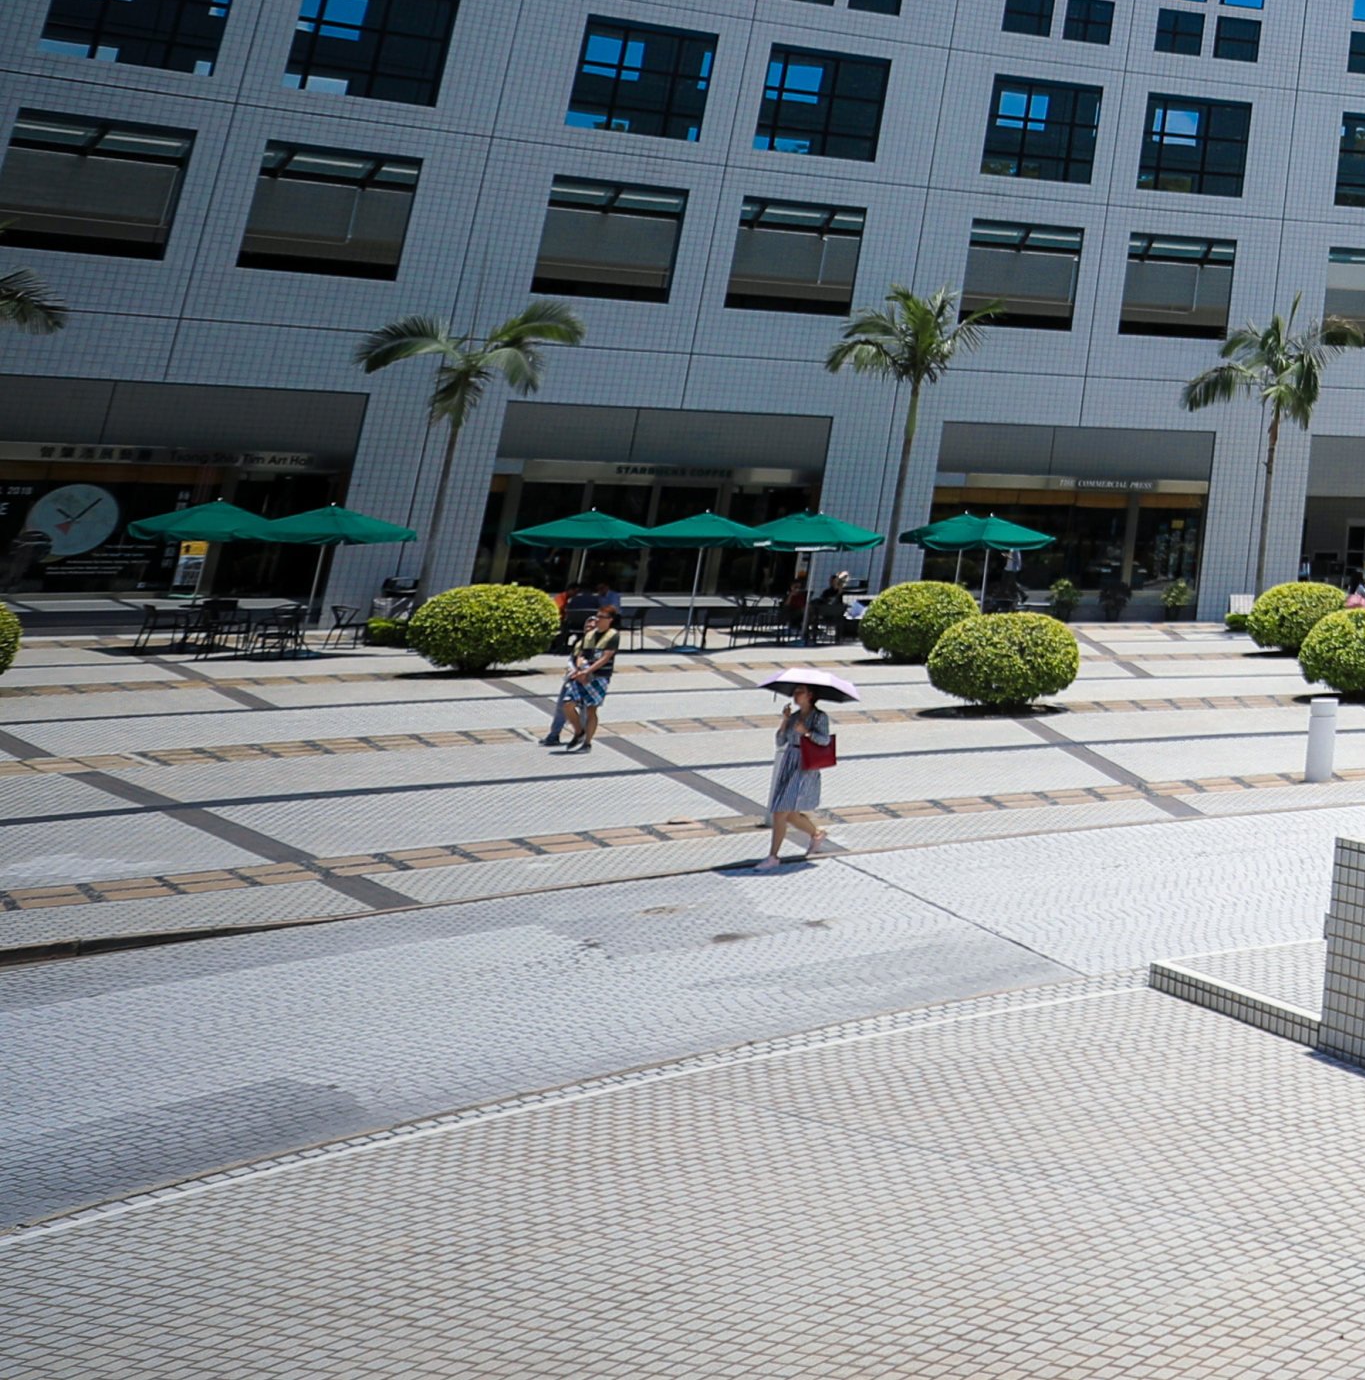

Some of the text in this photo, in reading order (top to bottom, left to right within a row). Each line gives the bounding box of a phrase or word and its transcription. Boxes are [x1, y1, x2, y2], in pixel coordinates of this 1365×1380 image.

[243, 453, 264, 464] Tim
[267, 455, 288, 465] Art
[290, 455, 315, 466] Hall
[616, 466, 732, 478] STARBUCKS COFFEE
[1078, 480, 1127, 488] COMMERCIAL
[1129, 481, 1153, 489] PRESS
